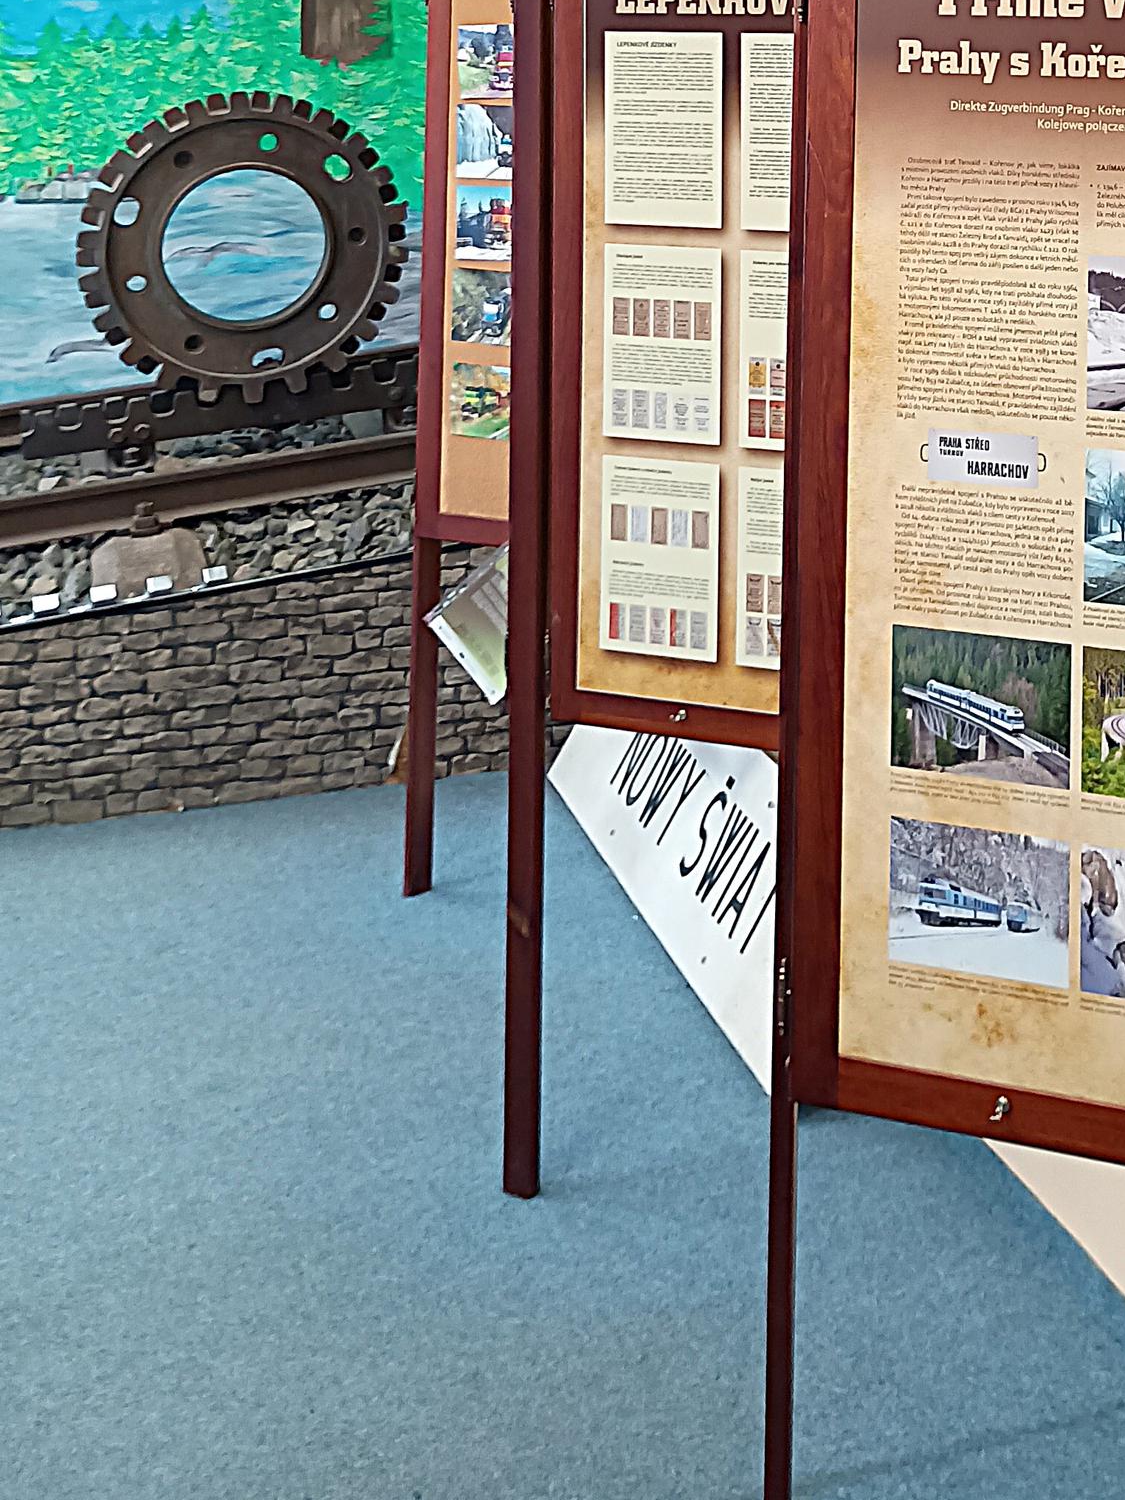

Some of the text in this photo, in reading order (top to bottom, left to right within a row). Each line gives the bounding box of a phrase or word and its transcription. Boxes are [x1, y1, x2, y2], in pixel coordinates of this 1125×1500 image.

[898, 40, 1000, 83] Prahy
[1011, 53, 1029, 75] s
[950, 99, 987, 112] Direkte
[987, 100, 1065, 116] Zugverbindung
[1064, 103, 1090, 117] Prag
[1037, 118, 1085, 133] Kolejowe
[939, 437, 989, 451] PRAHA STŘED
[968, 461, 1028, 479] HARRACHOV
[609, 732, 707, 846] NOWY
